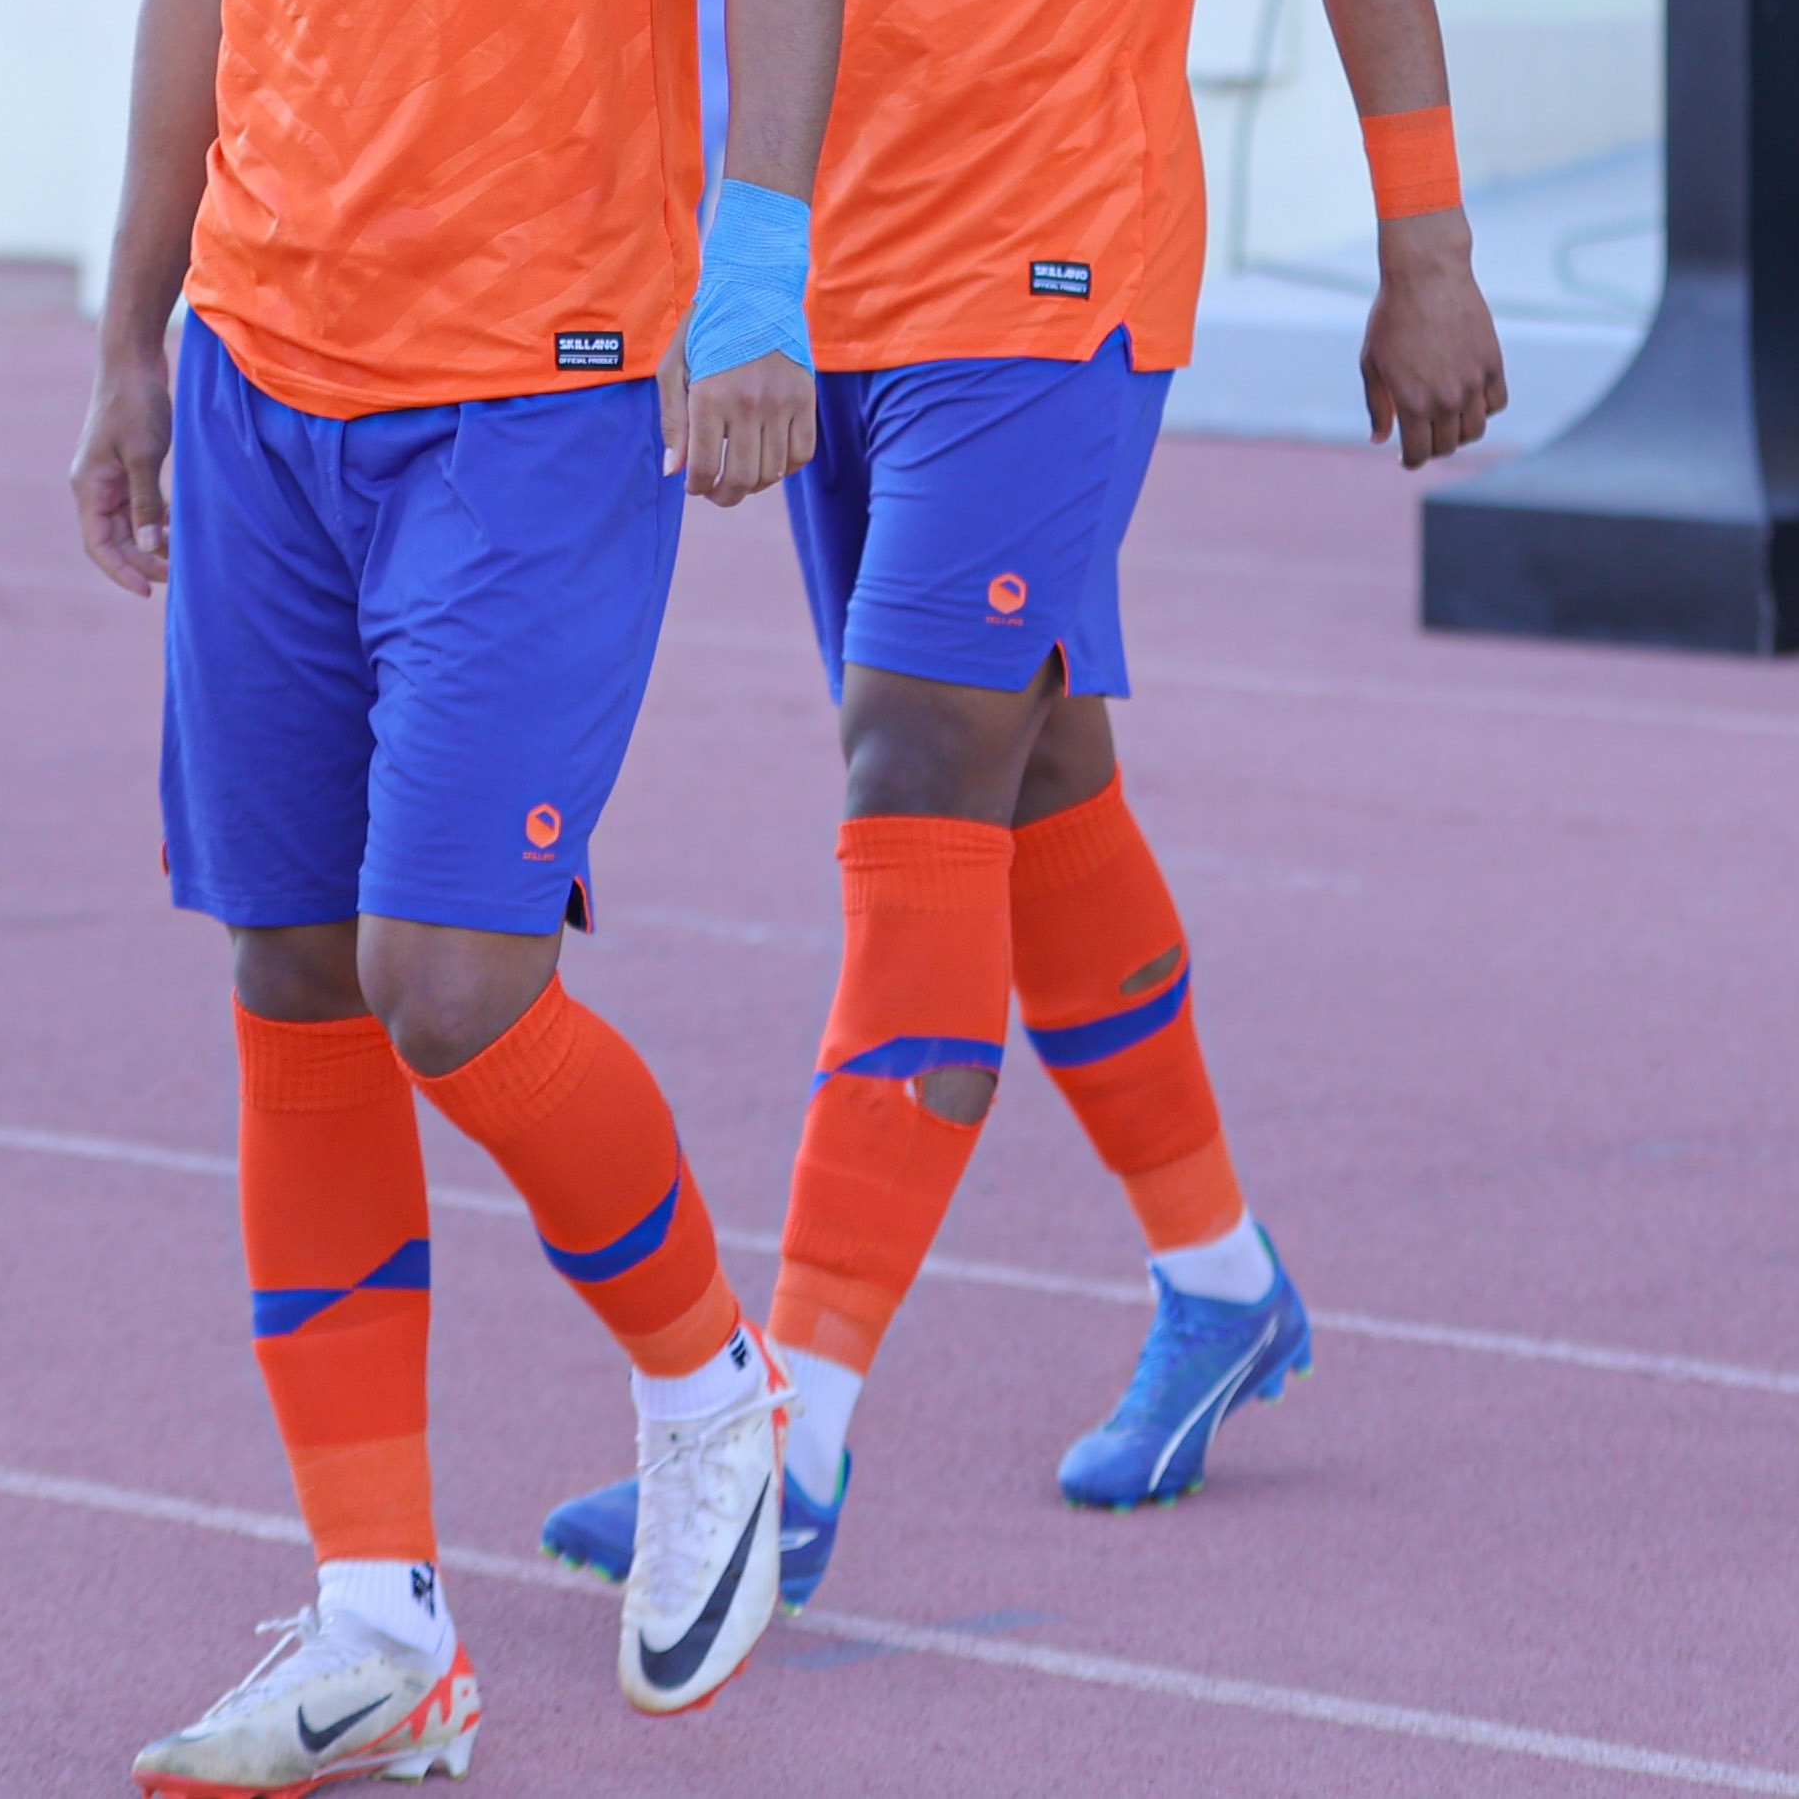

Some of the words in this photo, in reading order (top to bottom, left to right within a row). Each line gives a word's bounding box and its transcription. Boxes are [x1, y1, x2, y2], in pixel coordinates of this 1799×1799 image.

[1033, 265, 1089, 281] SKILLANO
[558, 338, 619, 351] SKILLANO
[558, 357, 588, 365] OFFICIAL
[588, 357, 618, 365] PRODUCT
